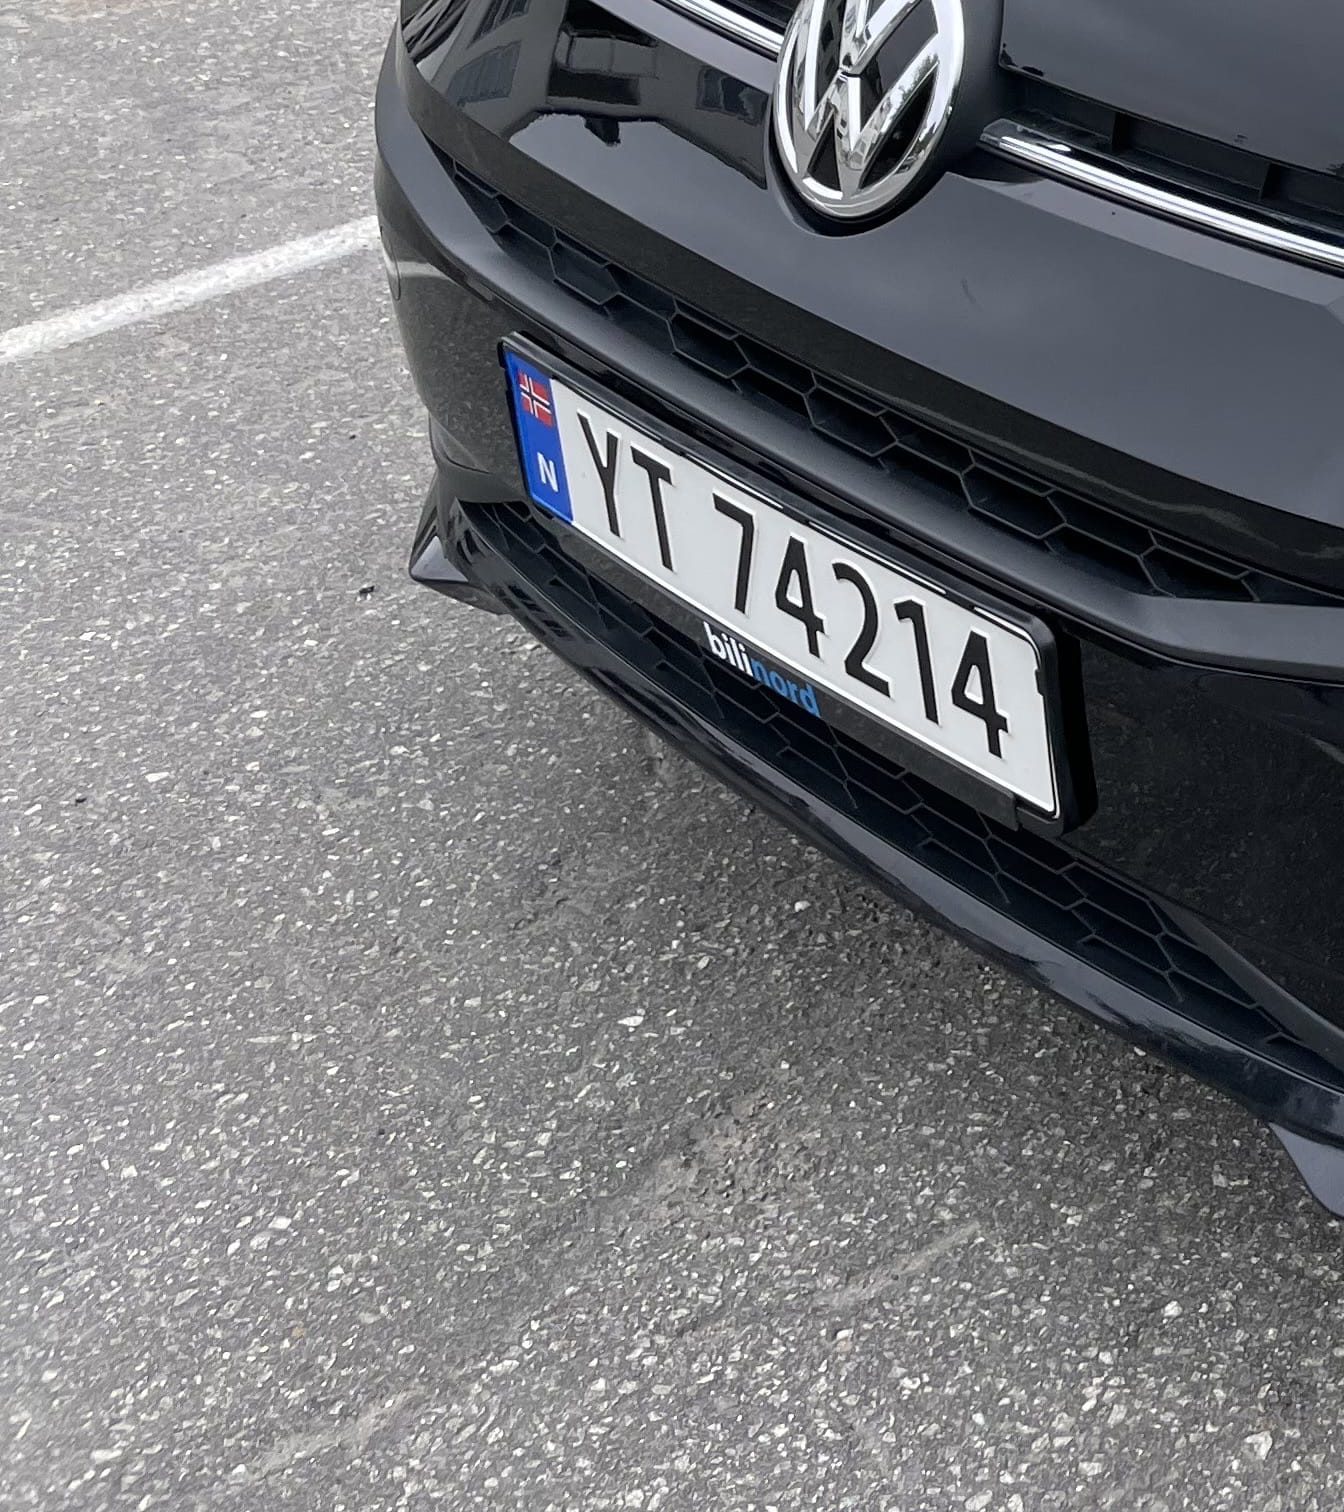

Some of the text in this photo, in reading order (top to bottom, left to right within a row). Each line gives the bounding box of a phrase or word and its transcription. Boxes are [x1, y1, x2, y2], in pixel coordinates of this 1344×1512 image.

[537, 452, 559, 492] N
[576, 408, 1009, 760] YT 74214
